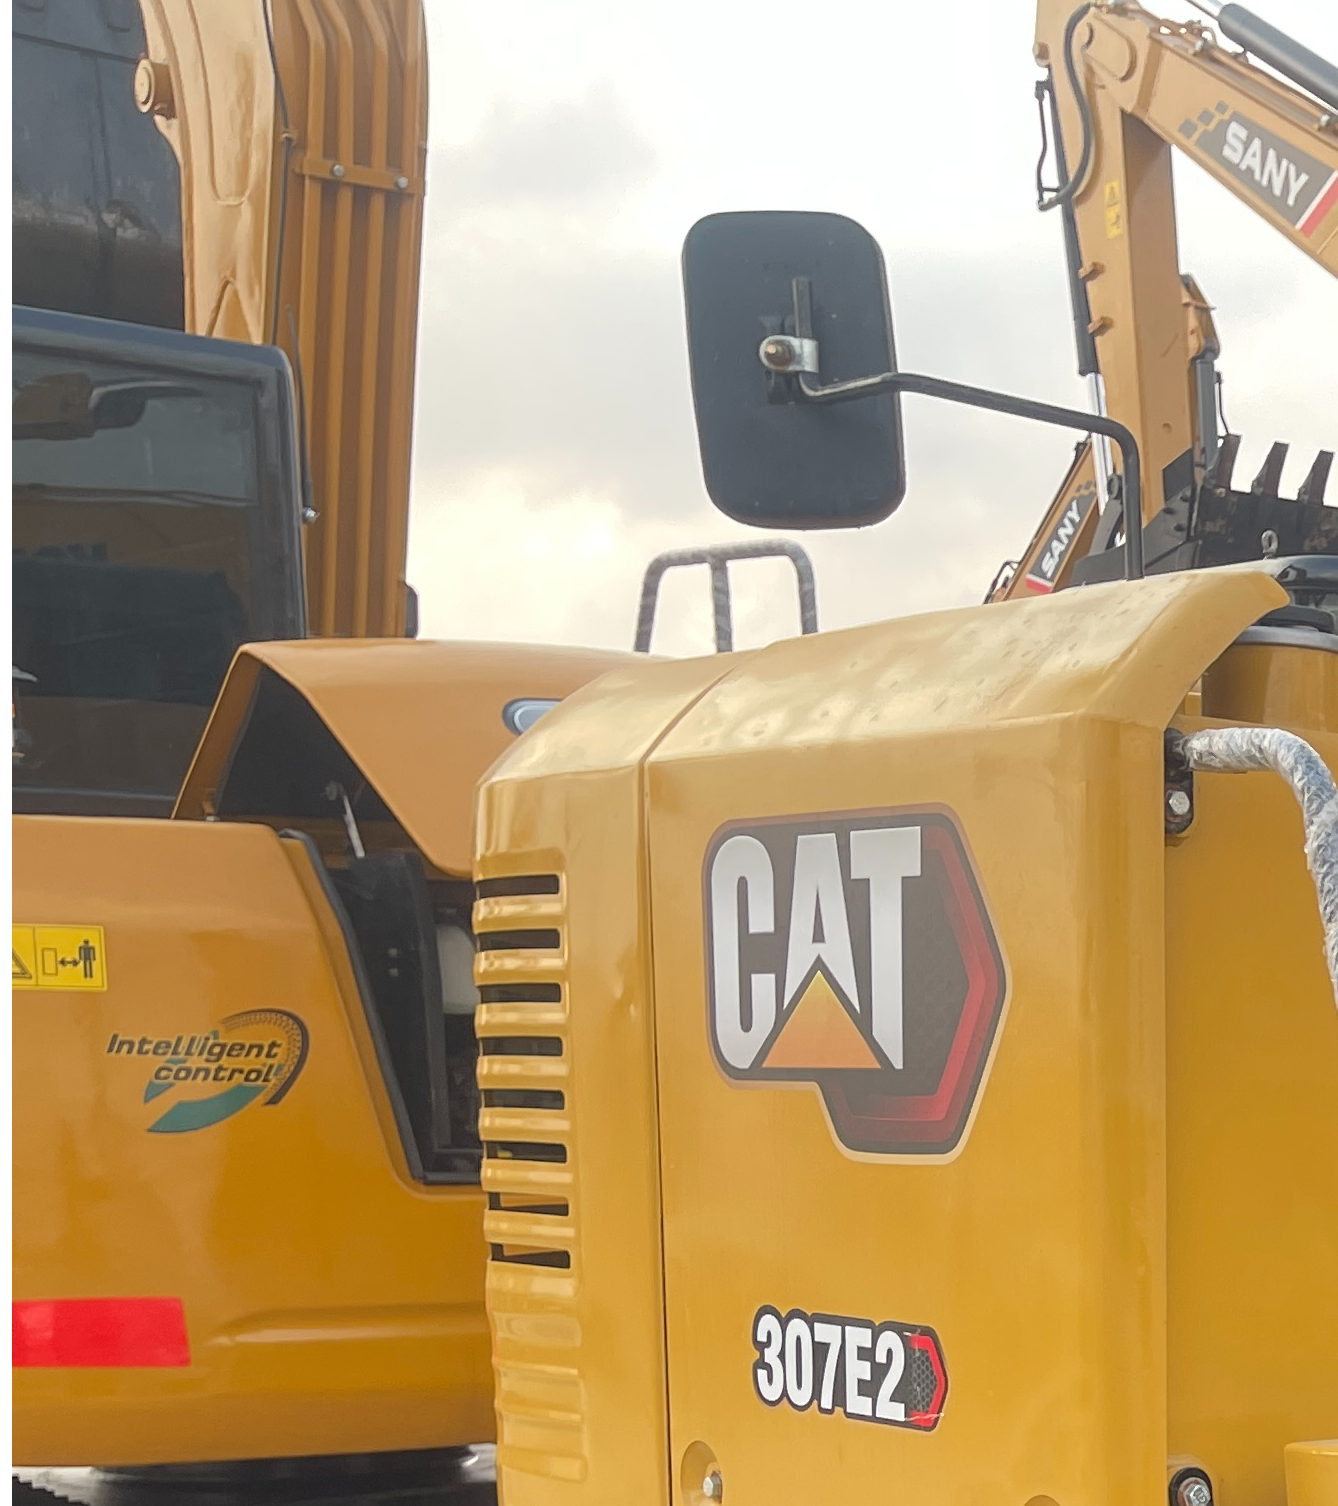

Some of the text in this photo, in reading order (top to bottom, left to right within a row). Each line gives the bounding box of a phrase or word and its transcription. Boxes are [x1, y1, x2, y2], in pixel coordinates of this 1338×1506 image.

[1221, 120, 1310, 207] SANY
[1041, 499, 1081, 580] SANY
[711, 825, 921, 1070] CAT
[106, 1032, 284, 1064] Intelligent
[153, 1062, 277, 1084] control
[756, 1313, 906, 1422] 307E2
